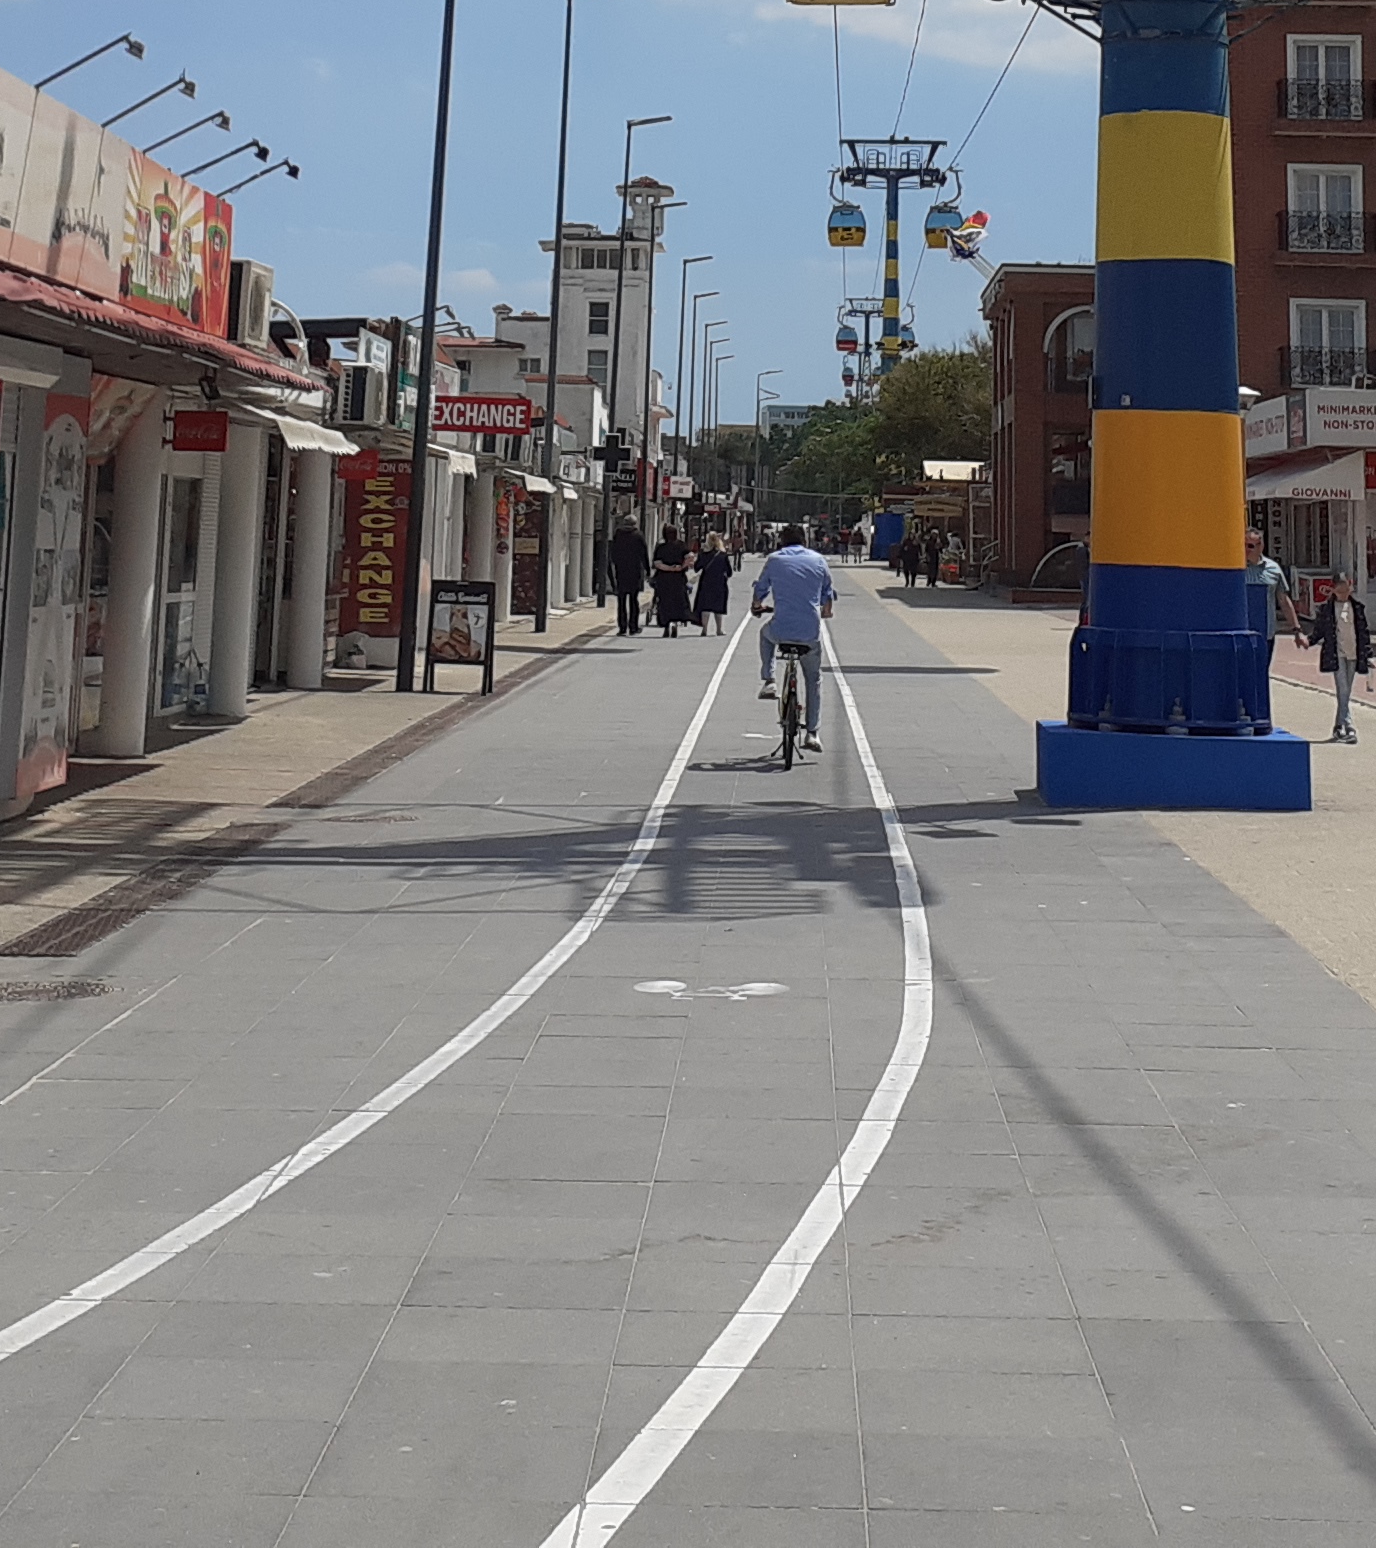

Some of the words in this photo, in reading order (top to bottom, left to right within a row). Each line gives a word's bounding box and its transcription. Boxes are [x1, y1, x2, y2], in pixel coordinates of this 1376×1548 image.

[432, 402, 528, 428] EXCHANGE
[1291, 487, 1352, 498] GIOVANNI
[356, 477, 397, 623] EXCHANGE
